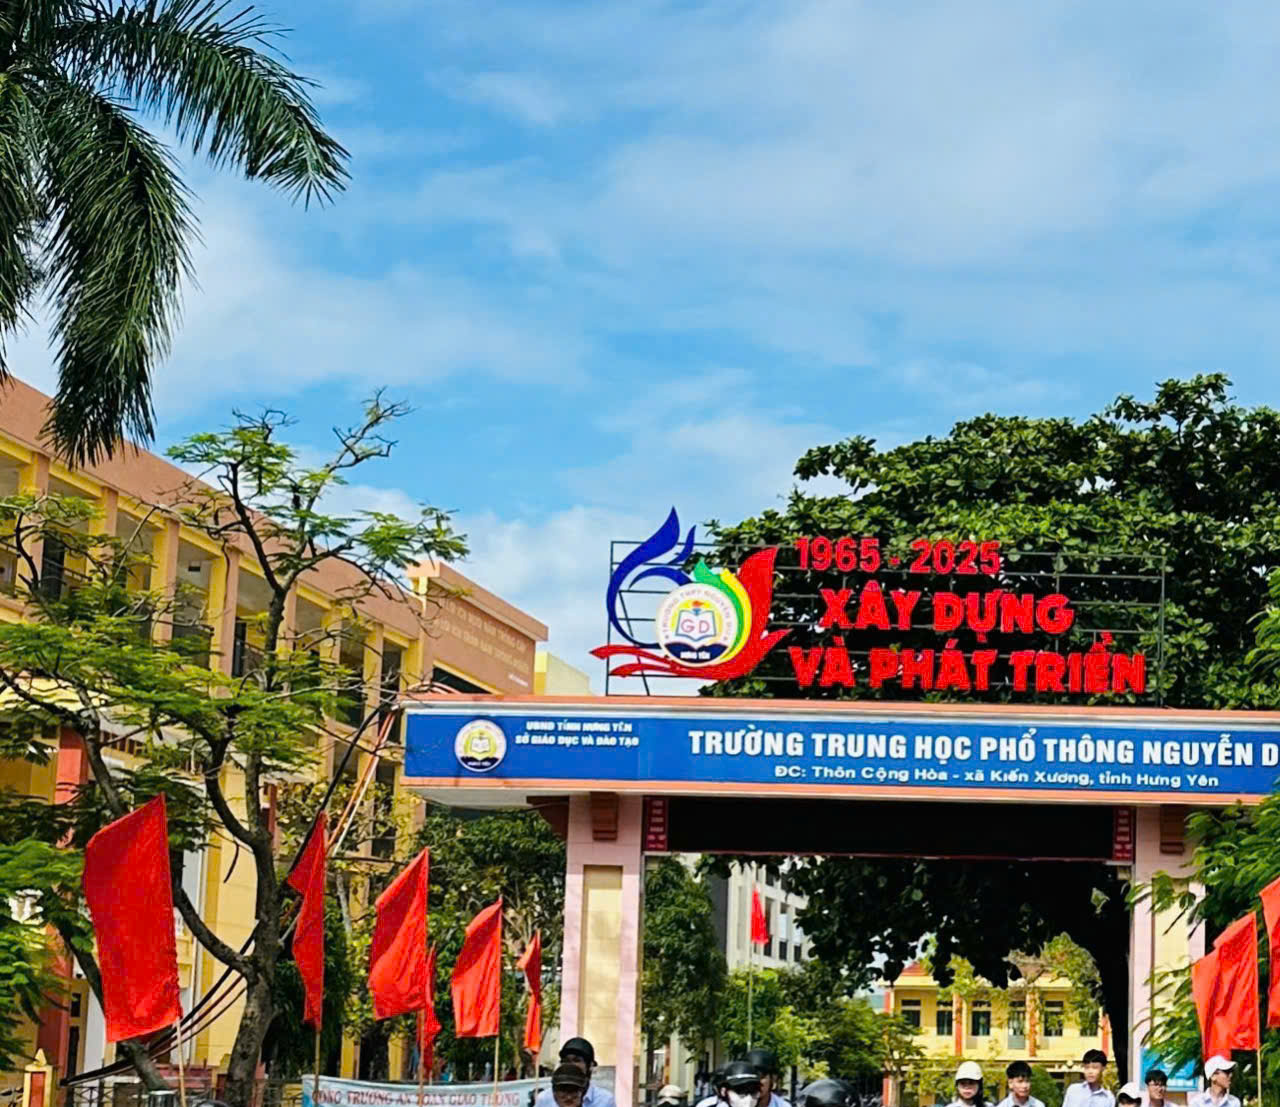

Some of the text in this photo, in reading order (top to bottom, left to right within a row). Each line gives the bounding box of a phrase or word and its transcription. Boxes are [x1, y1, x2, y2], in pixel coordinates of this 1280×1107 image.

[795, 536, 880, 573] 1965
[910, 539, 1000, 575] 2025
[819, 580, 1075, 643] XÂY DỰNG
[788, 631, 1146, 694] VÀ PHÁT TRIỂN
[515, 731, 529, 744] SỞ
[531, 732, 556, 745] GIÁO
[557, 734, 579, 748] DỤC
[581, 734, 594, 746] VÀ
[618, 736, 640, 748] TẠO
[688, 724, 805, 757] TRƯỜNG
[811, 732, 908, 760] TRUNG
[914, 735, 973, 765] HỌC
[980, 727, 1037, 763] PHỔ
[1043, 733, 1135, 765] THÔNG
[1142, 733, 1254, 767] NGUYỄN
[774, 765, 806, 778] ĐC:
[812, 765, 856, 779] Thôn
[861, 766, 909, 783] Cộng
[914, 768, 948, 782] Hòa
[964, 768, 985, 782] xã
[1034, 770, 1094, 787] Xương,
[1098, 770, 1132, 785] tỉnh
[1136, 773, 1182, 789] Hưng
[1186, 773, 1219, 788] Yên
